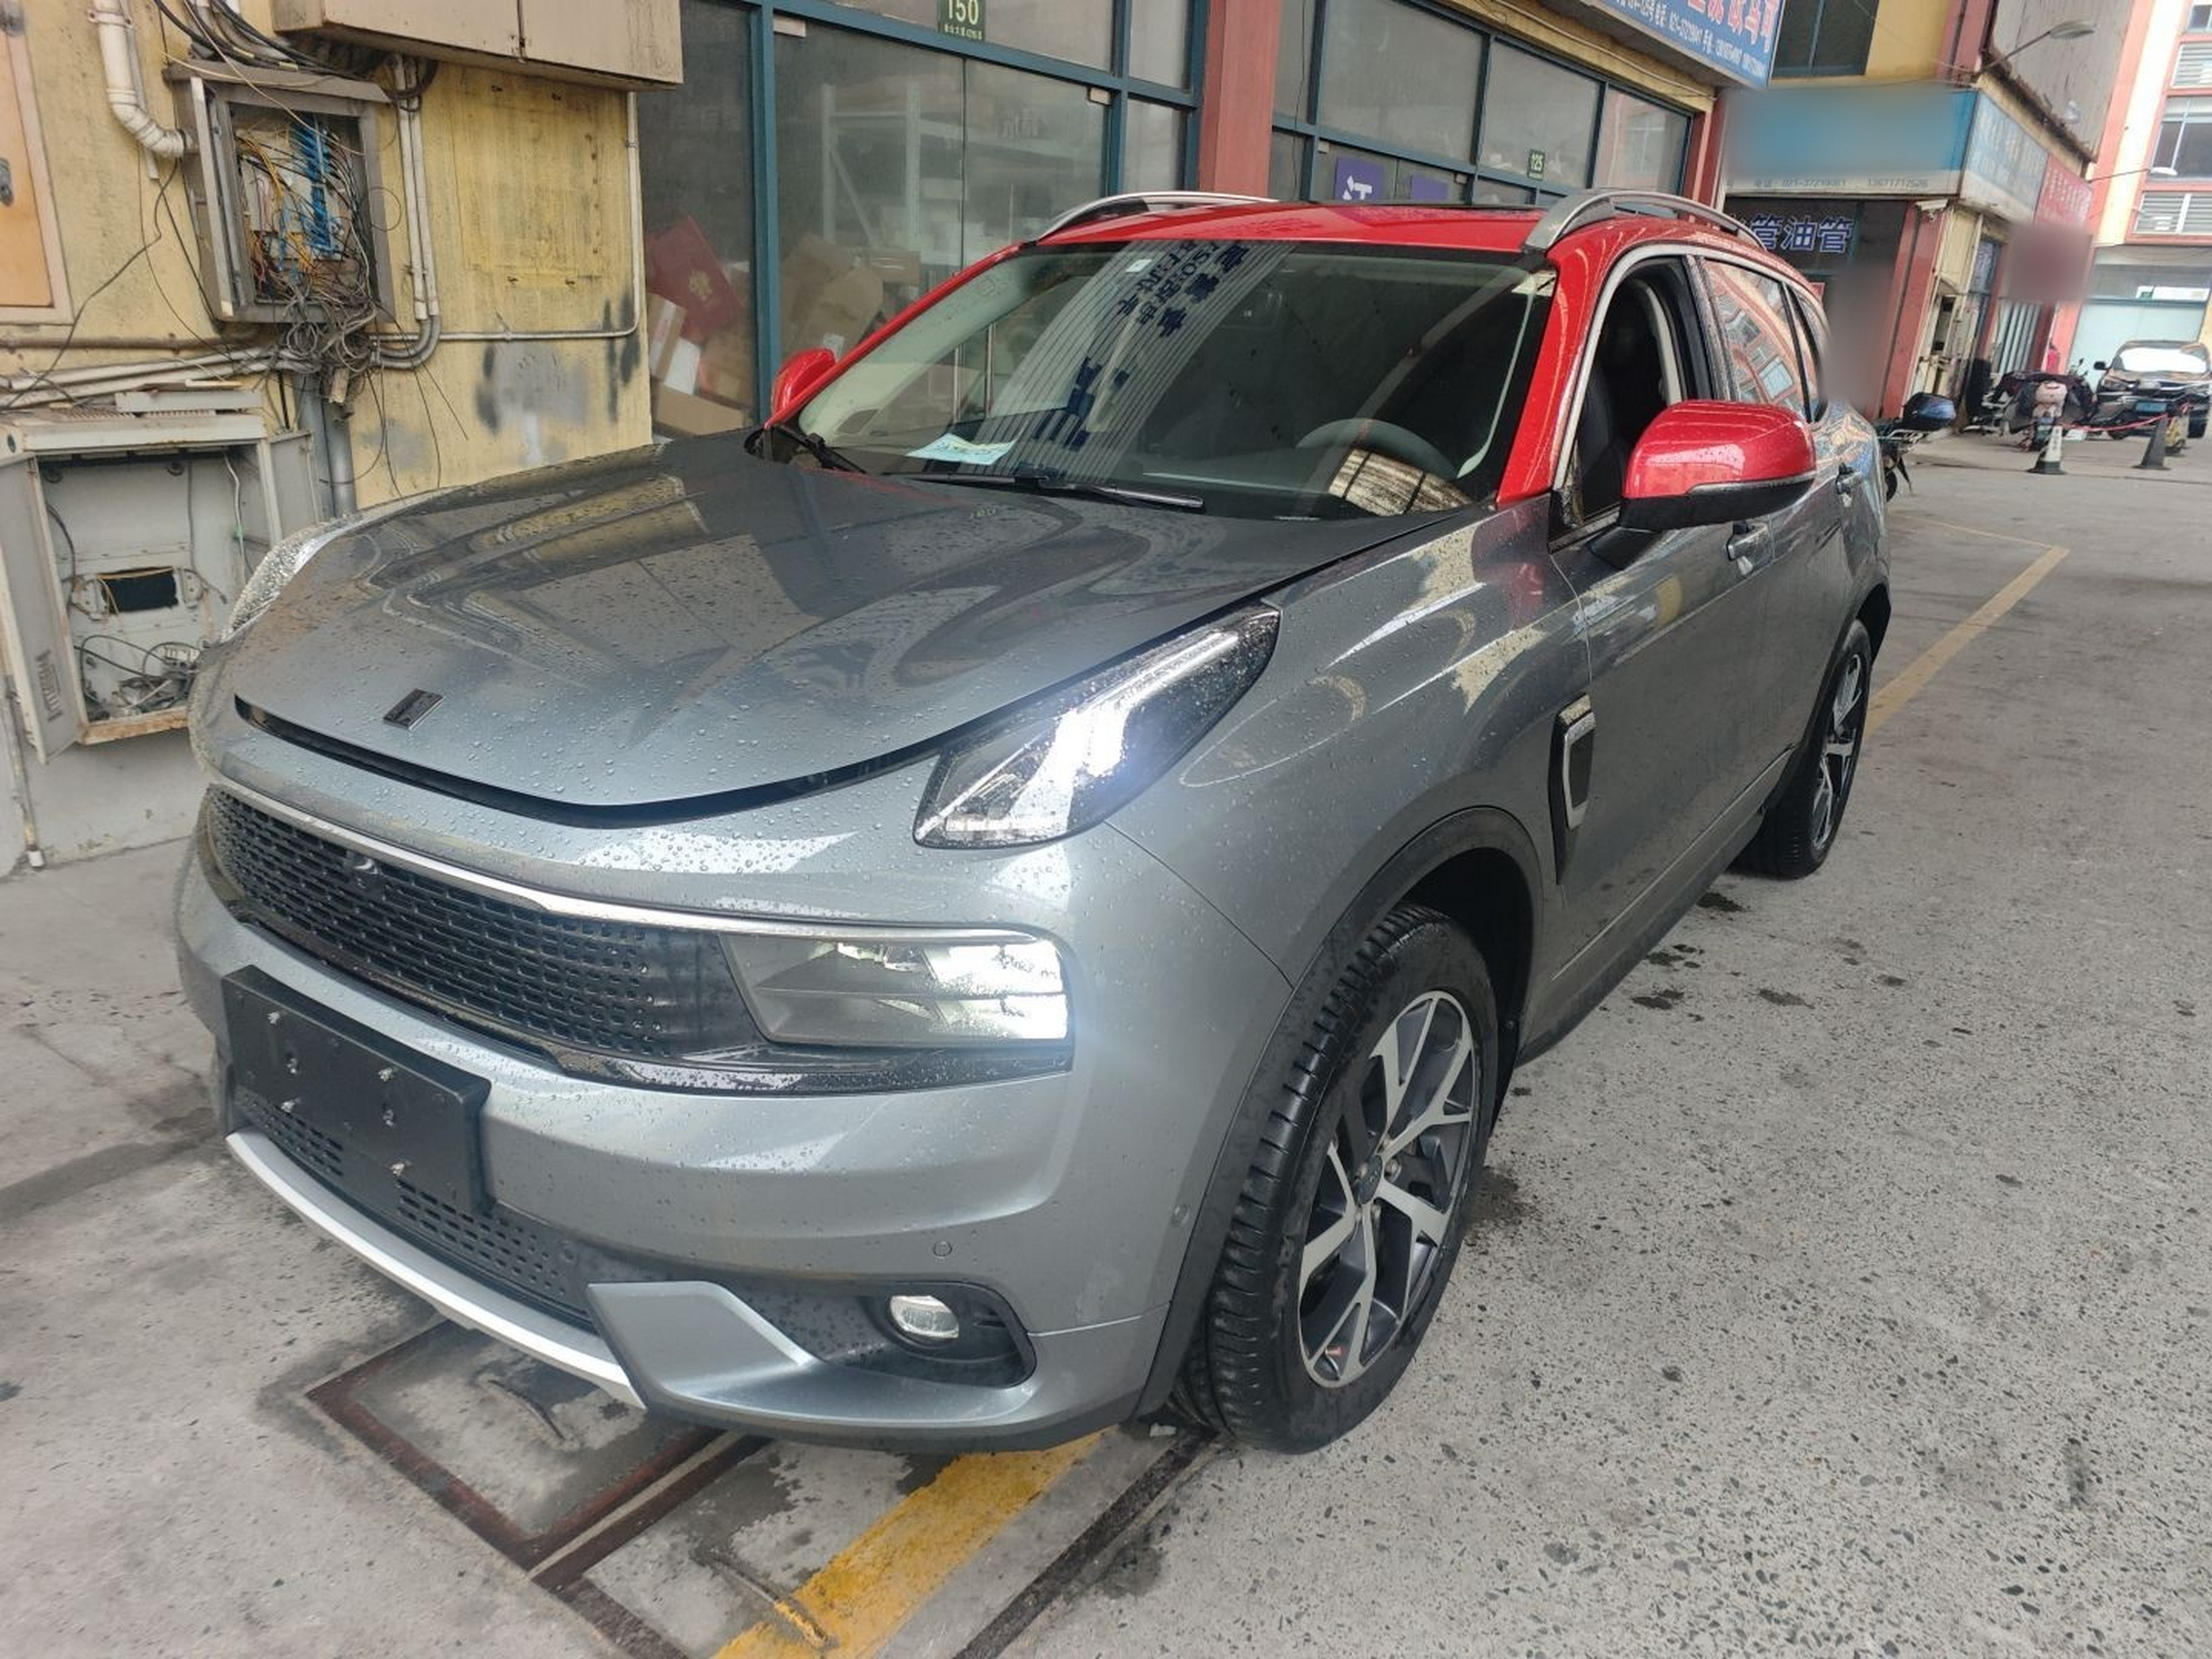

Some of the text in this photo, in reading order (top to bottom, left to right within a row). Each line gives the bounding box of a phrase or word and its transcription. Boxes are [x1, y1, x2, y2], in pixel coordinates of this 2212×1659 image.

[948, 0, 979, 25] 150
[1531, 153, 1543, 171] 125
[1730, 213, 1854, 253] 管油管
